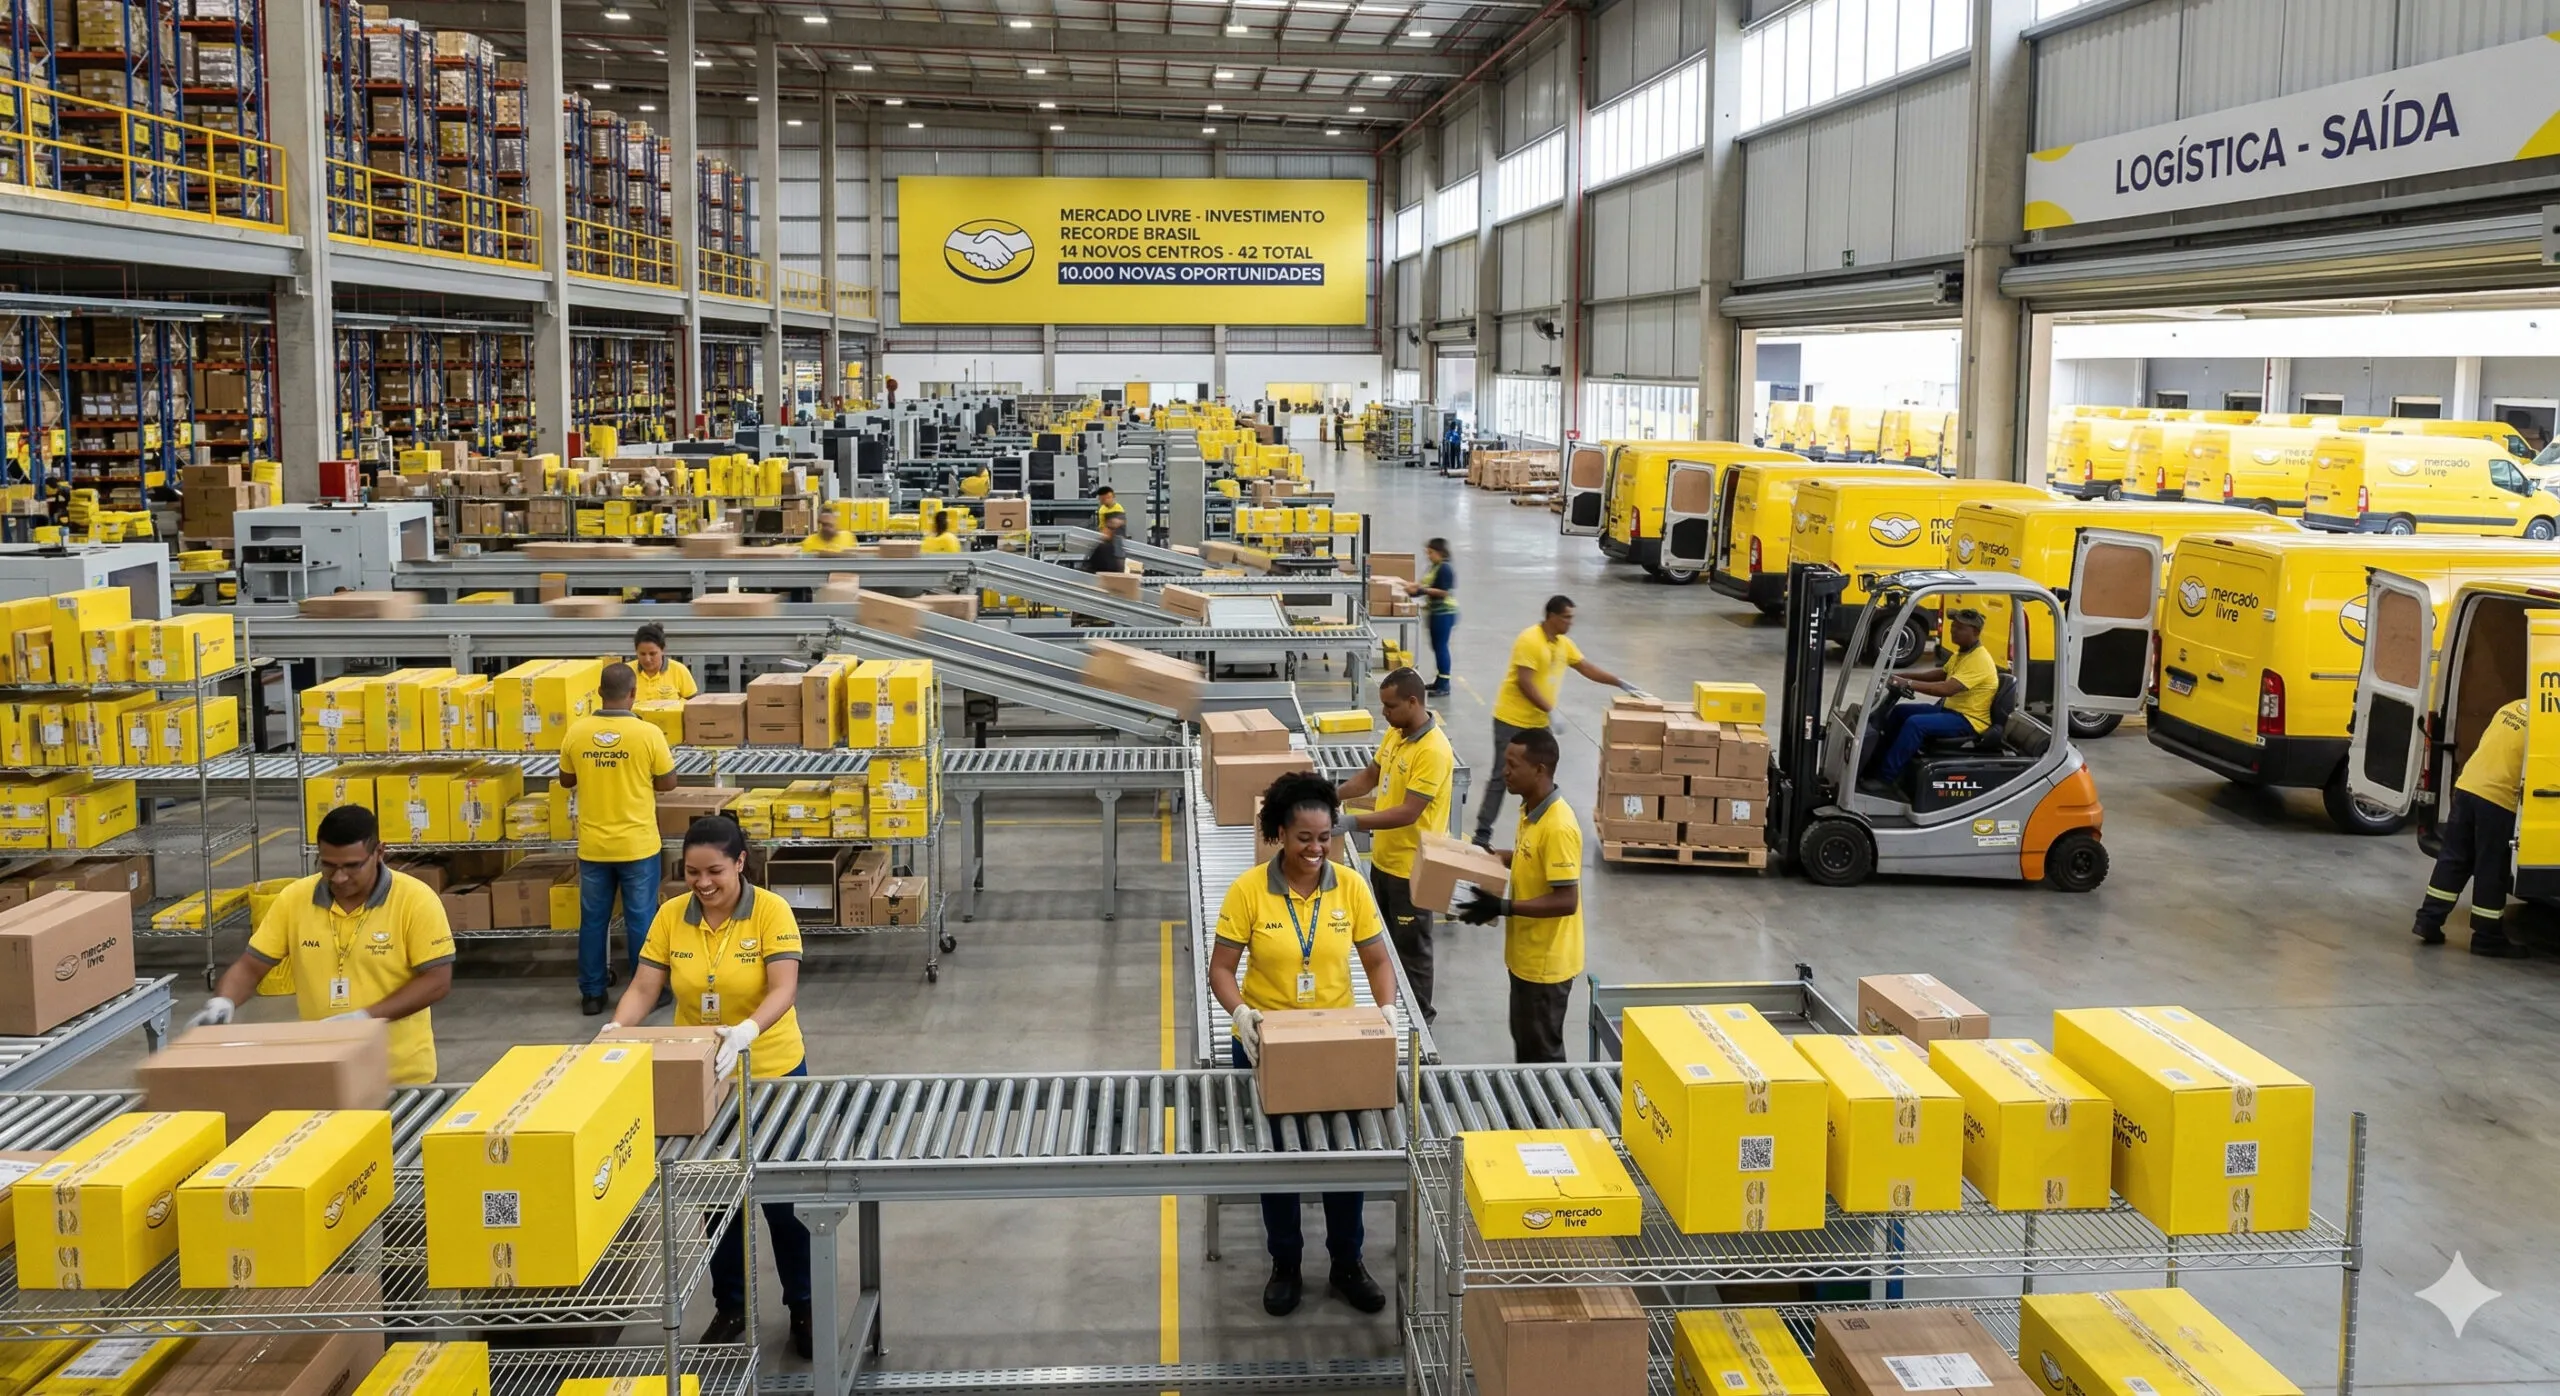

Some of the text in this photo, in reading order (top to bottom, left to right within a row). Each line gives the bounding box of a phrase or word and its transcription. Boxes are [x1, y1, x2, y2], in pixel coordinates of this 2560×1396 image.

[2115, 127, 2286, 195] LOGÍSTICA
[2321, 88, 2461, 160] SAÍDA
[1060, 208, 1142, 222] MERCADO
[1146, 209, 1191, 222] LIVRE
[1205, 209, 1325, 223] INVESTIMENTO
[1060, 226, 1201, 240] RECORDE BRASIL
[1060, 245, 1077, 258] 14
[1082, 245, 1142, 258] NOVOS
[1146, 245, 1224, 259] CENTROS
[1237, 246, 1258, 259] 42
[1262, 246, 1313, 259] TOTAL
[1060, 266, 1322, 281] 10.000 NOVAS OPORTUNIDADES
[2424, 458, 2470, 468] mercado
[2211, 586, 2259, 610] mercado
[2215, 603, 2239, 622] livre
[582, 749, 630, 759] mercado
[595, 758, 617, 768] livre
[1932, 781, 1983, 789] STILL
[1264, 922, 1284, 930] ANA
[80, 936, 117, 960] mercado
[301, 939, 321, 948] ANA
[2112, 1108, 2148, 1144] ercado
[1555, 1206, 1603, 1218] mercado
[1564, 1217, 1587, 1228] livre
